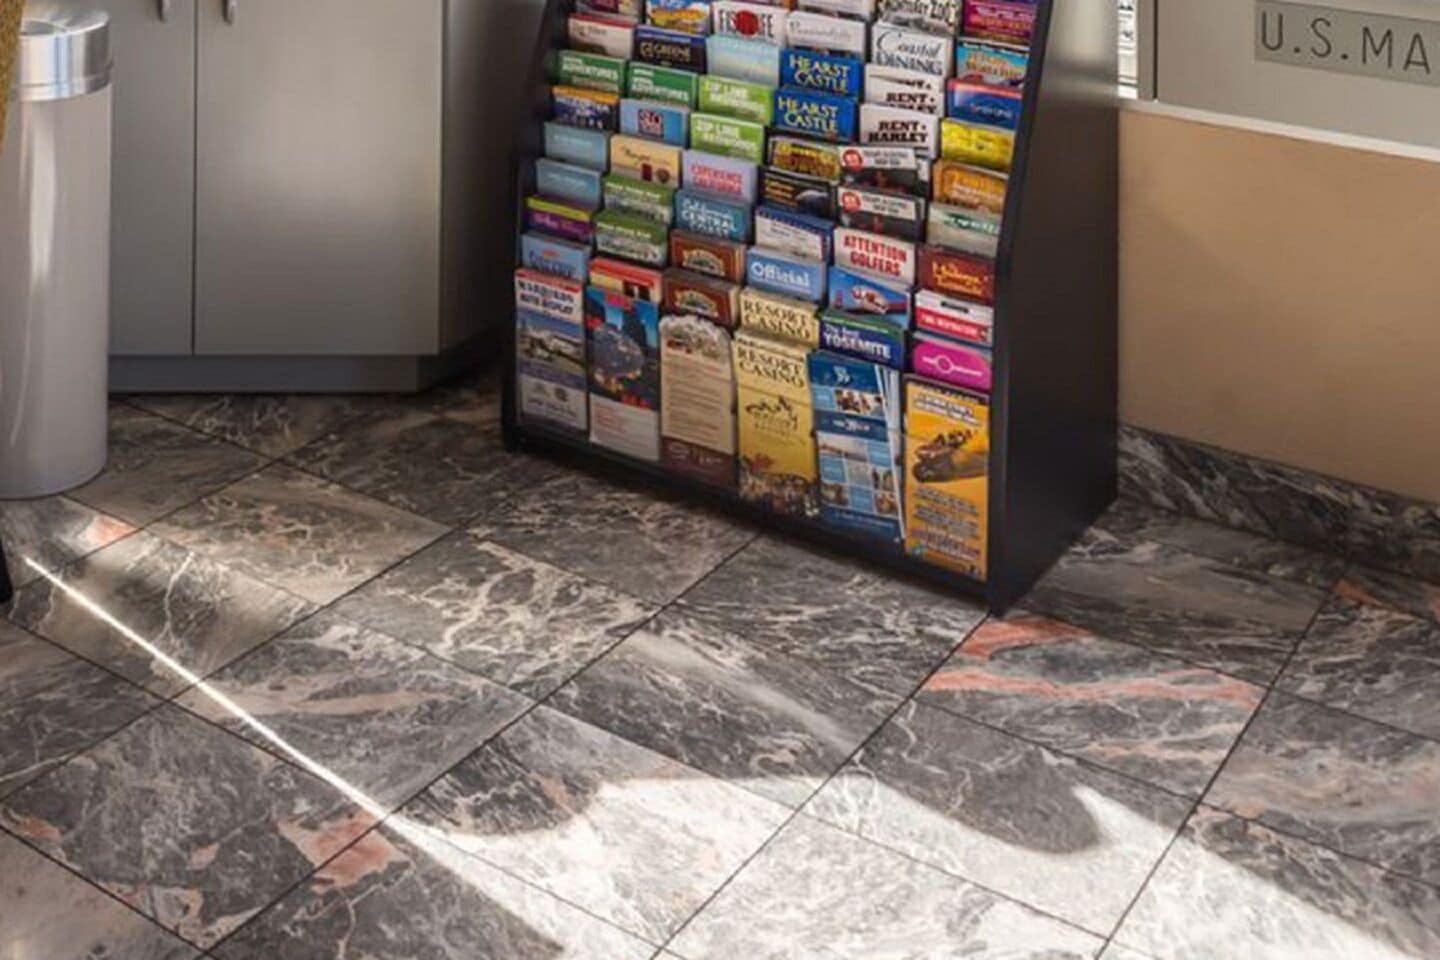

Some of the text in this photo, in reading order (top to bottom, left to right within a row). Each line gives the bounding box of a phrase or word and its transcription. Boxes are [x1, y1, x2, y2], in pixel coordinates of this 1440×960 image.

[789, 53, 851, 78] HEARST
[875, 50, 943, 76] DINING
[794, 69, 849, 94] CASTLE
[777, 95, 839, 117] HEARST
[886, 91, 927, 104] RENT
[784, 112, 839, 134] CASTLE
[878, 120, 920, 132] RENT
[868, 129, 928, 144] HARLEY
[681, 209, 737, 232] CENTRAL
[843, 234, 908, 263] ATTENTION
[750, 260, 810, 286] Official
[850, 251, 901, 278] GOLFERS
[742, 298, 809, 327] RESORT
[743, 313, 811, 340] CASINO
[736, 343, 803, 373] RESORT
[823, 332, 891, 361] YOSEMITE
[738, 359, 805, 389] CASINO
